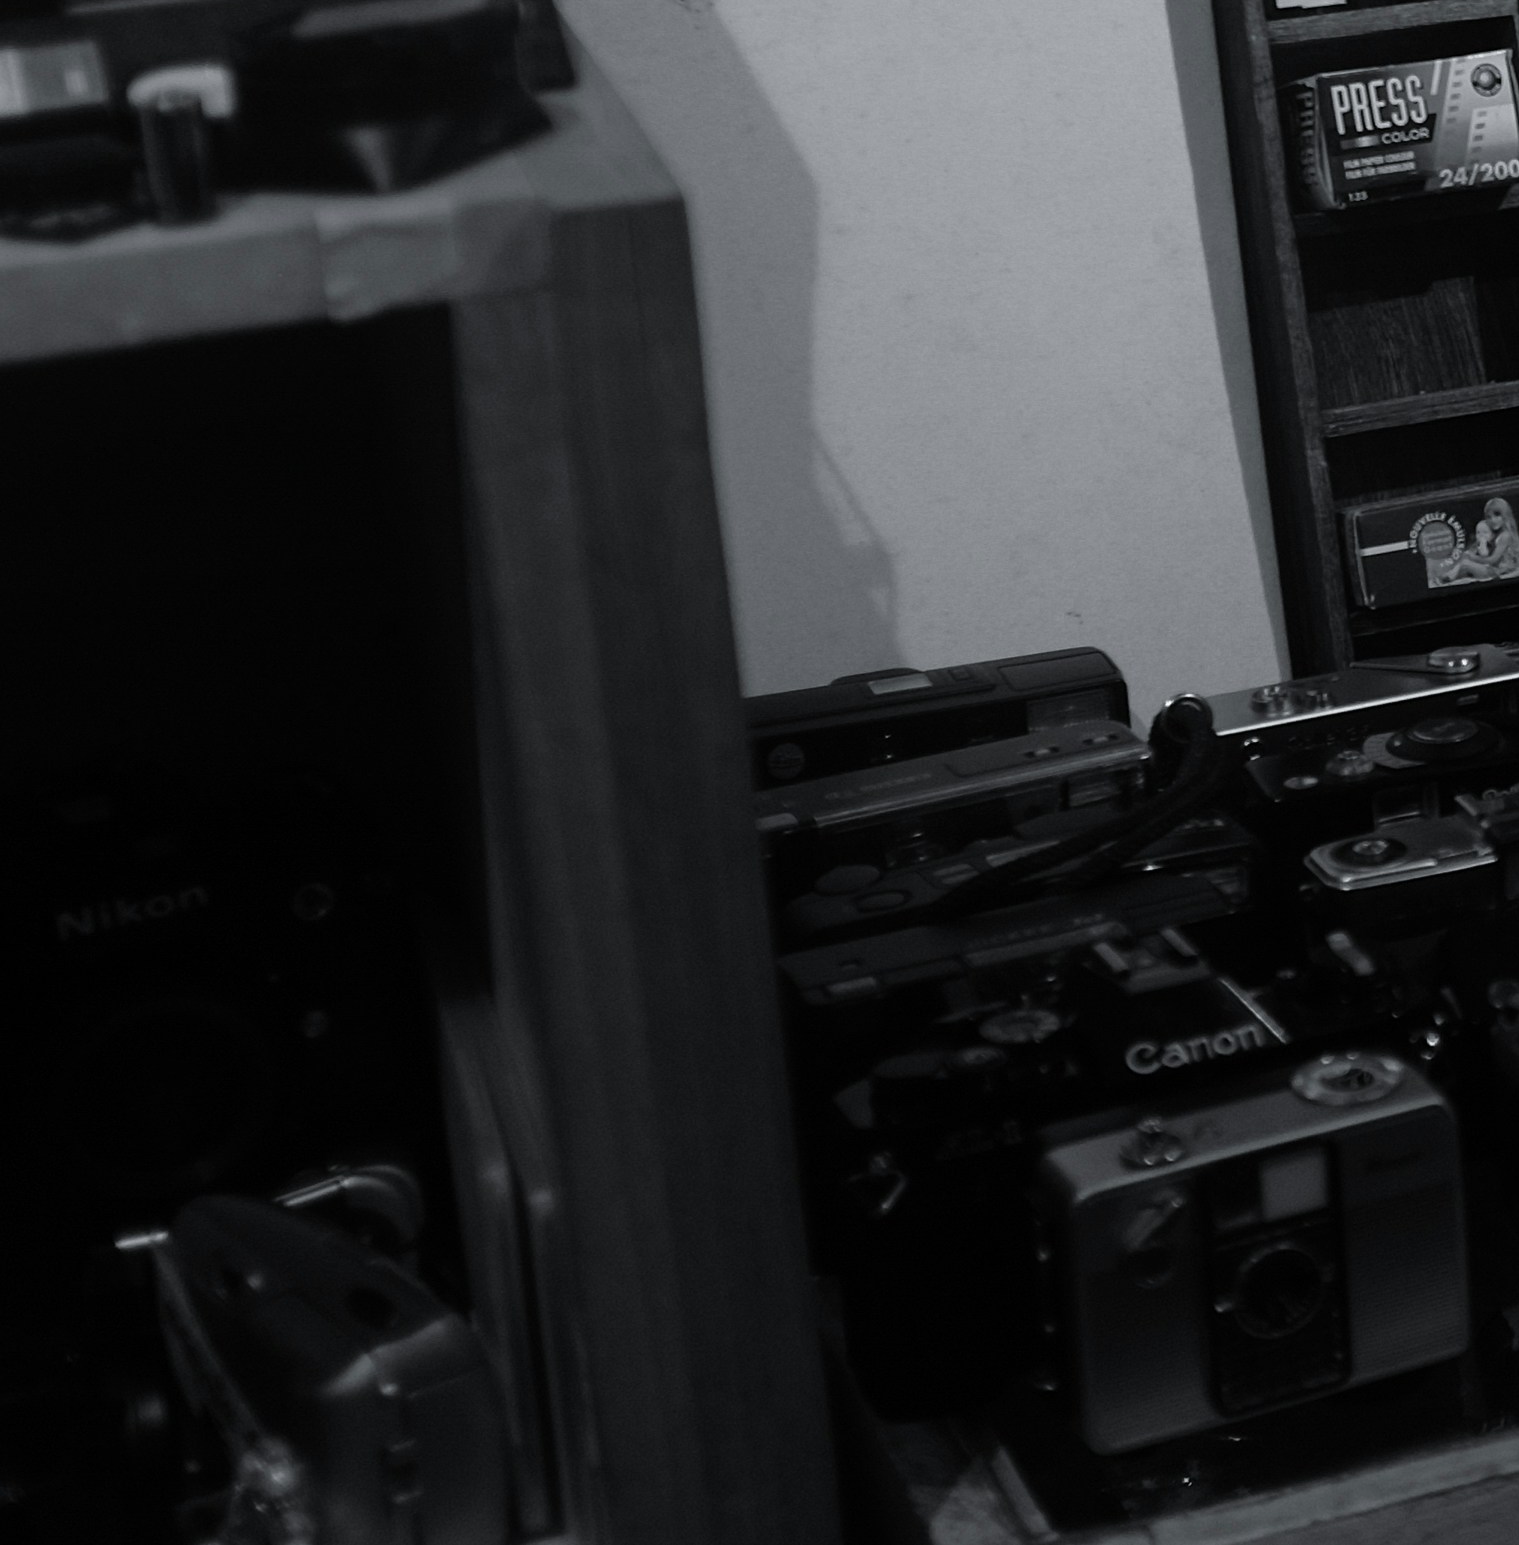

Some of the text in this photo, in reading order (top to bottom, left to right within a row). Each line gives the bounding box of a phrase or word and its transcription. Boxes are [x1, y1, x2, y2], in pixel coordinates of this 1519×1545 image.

[1330, 74, 1429, 136] PRESS
[1381, 127, 1430, 145] COLOR
[54, 882, 211, 944] Nikon
[1124, 1022, 1267, 1076] Canon
